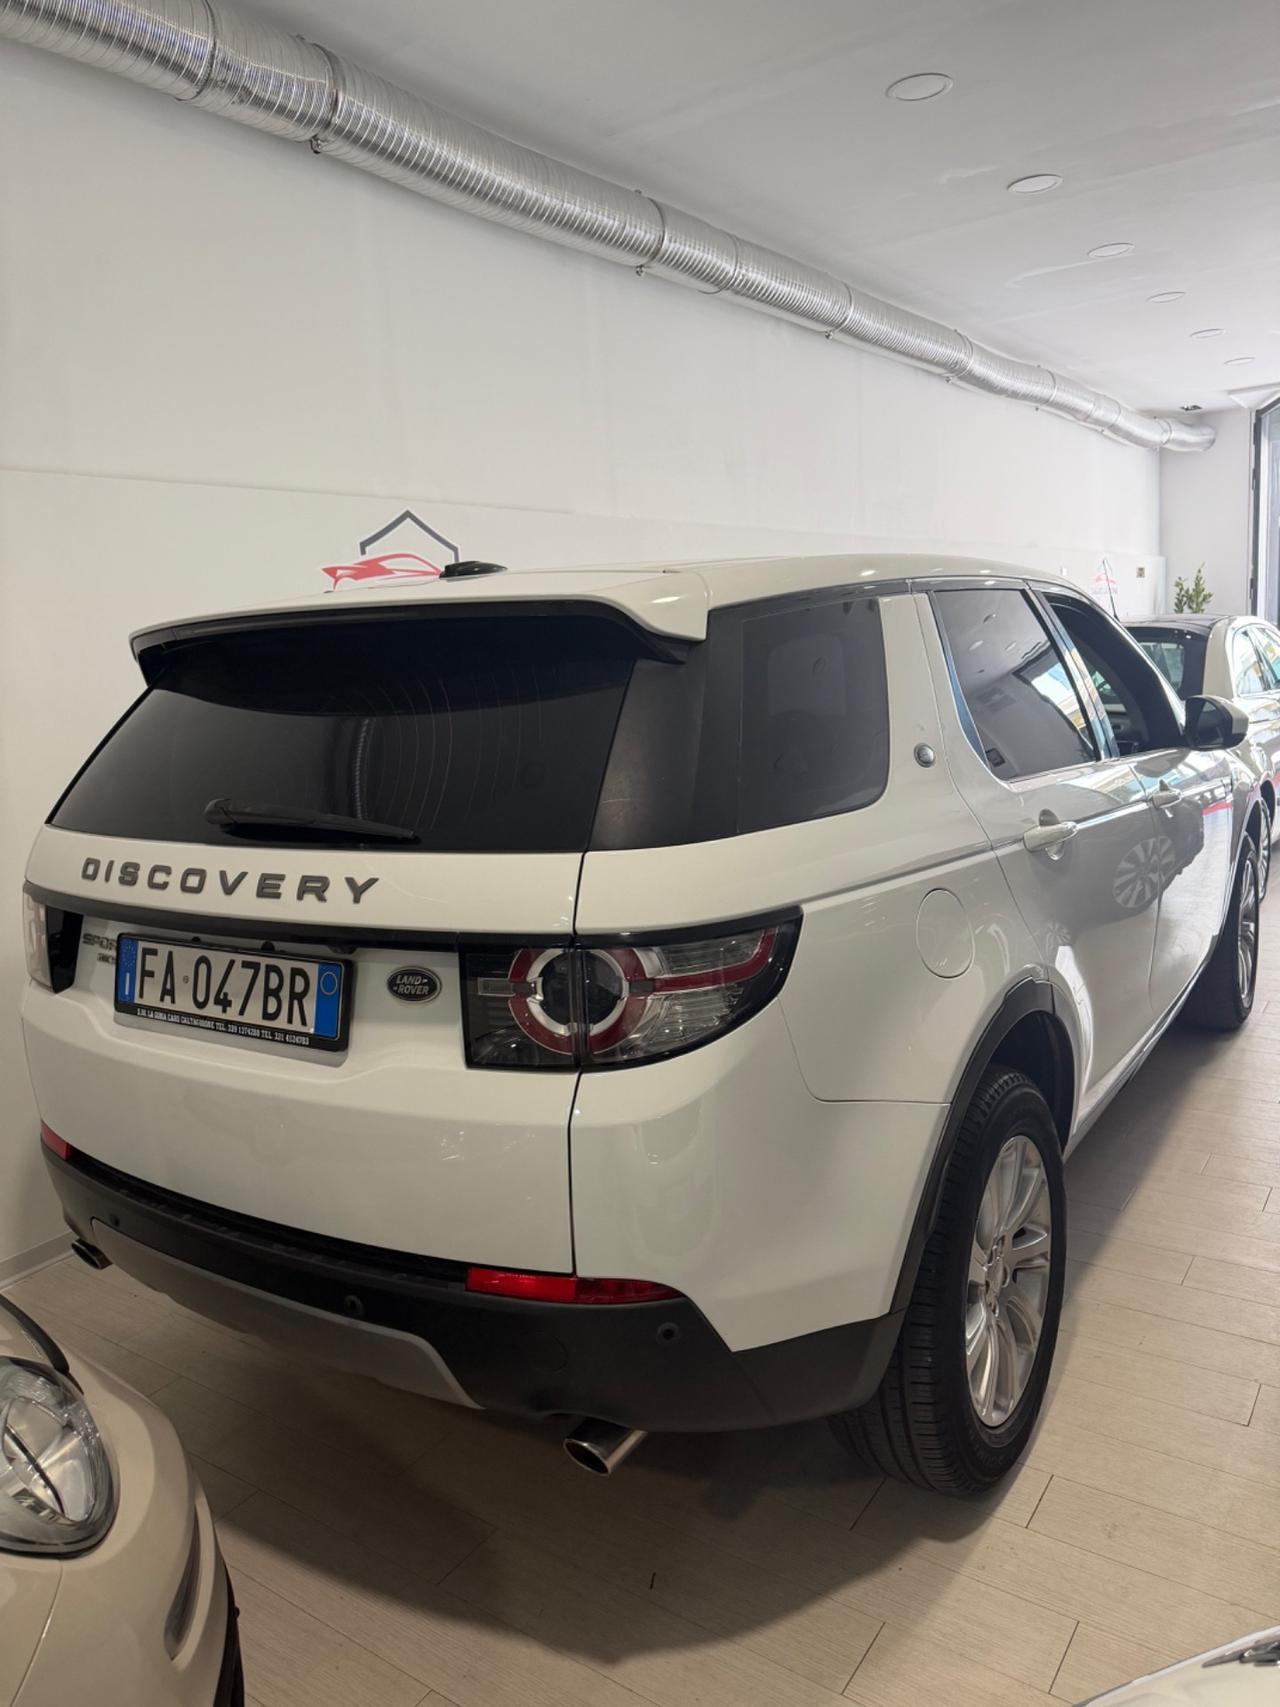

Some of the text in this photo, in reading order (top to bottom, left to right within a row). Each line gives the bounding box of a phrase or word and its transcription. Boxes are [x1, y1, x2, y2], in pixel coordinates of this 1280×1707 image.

[80, 857, 380, 904] DISCOVERY
[138, 947, 311, 1027] FA 047BR
